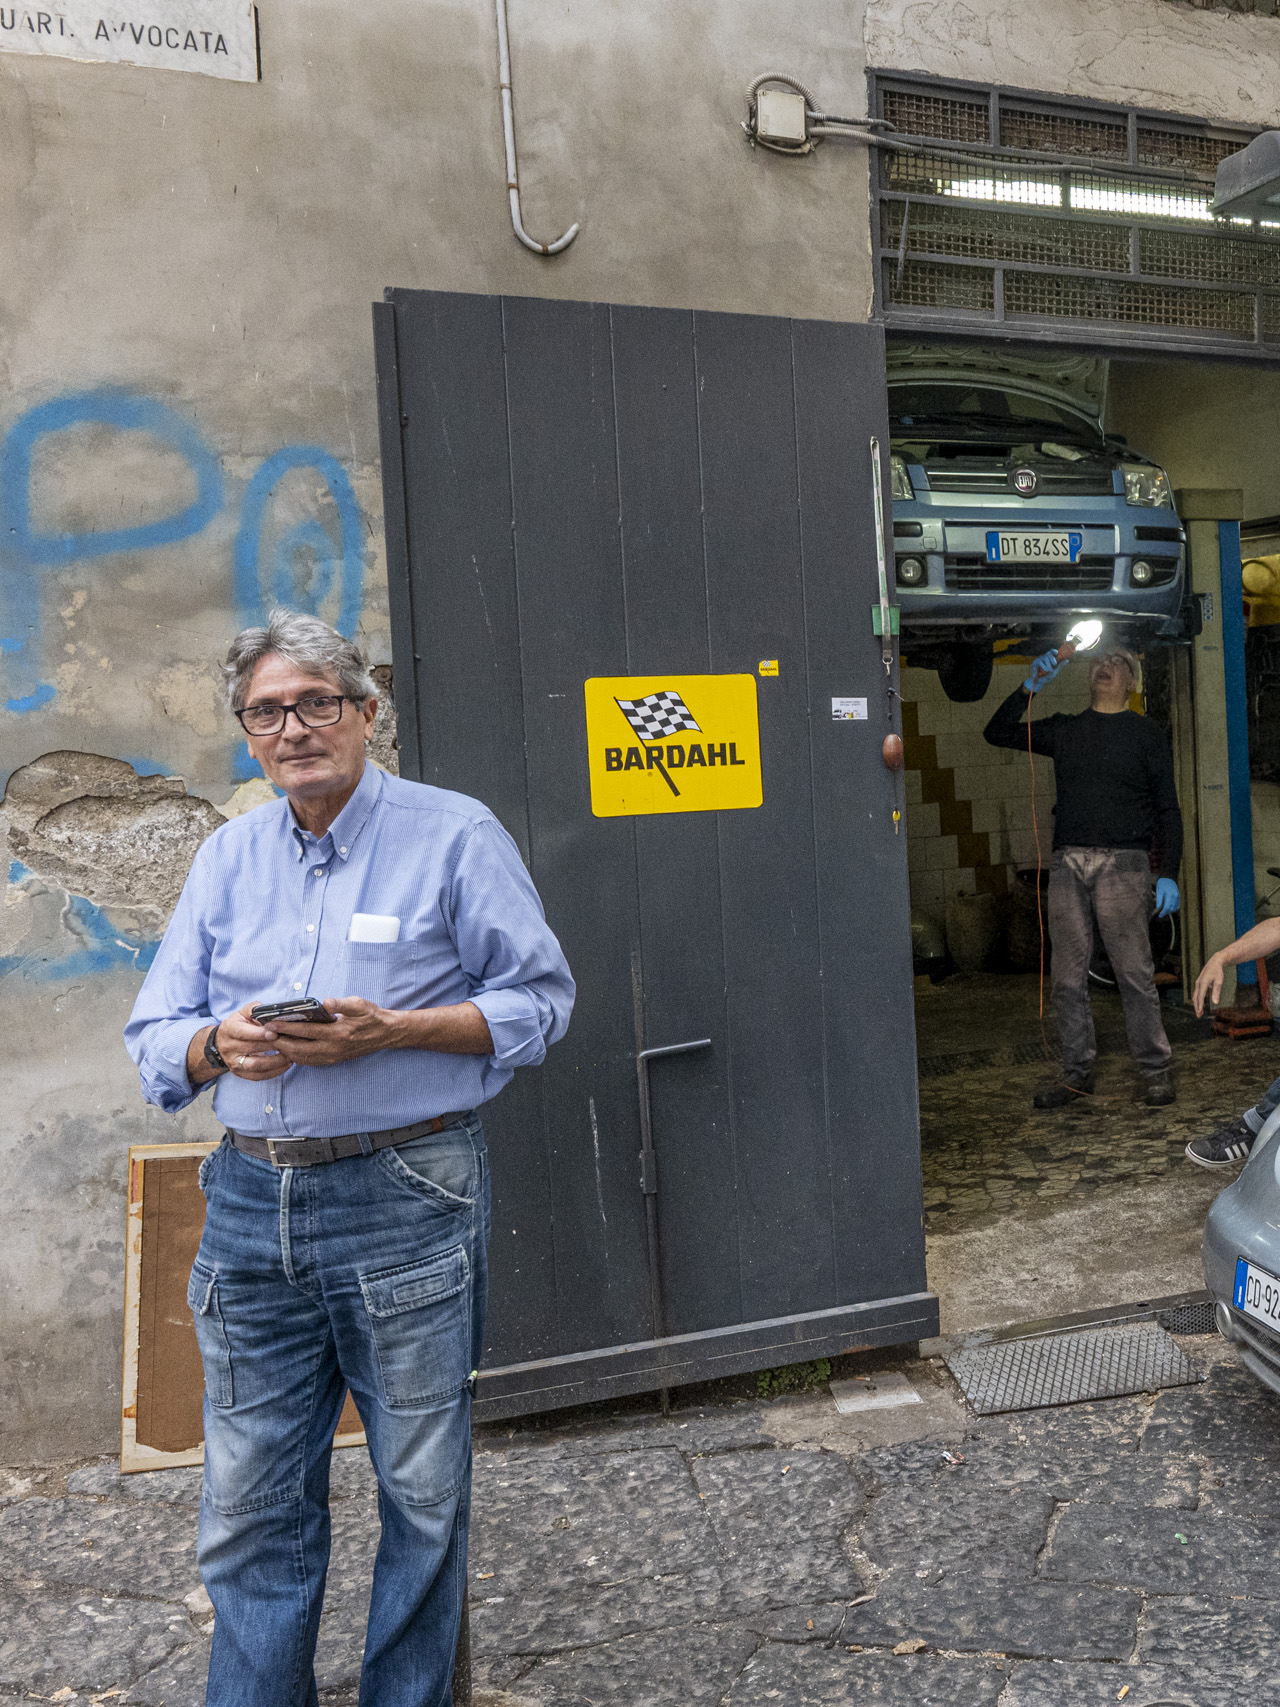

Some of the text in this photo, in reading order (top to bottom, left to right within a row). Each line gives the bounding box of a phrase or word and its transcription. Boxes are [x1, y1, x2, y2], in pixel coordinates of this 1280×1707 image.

[1001, 537, 1069, 556] DT 834SS
[605, 742, 745, 772] BARDAHL
[1246, 1276, 1261, 1308] CD
